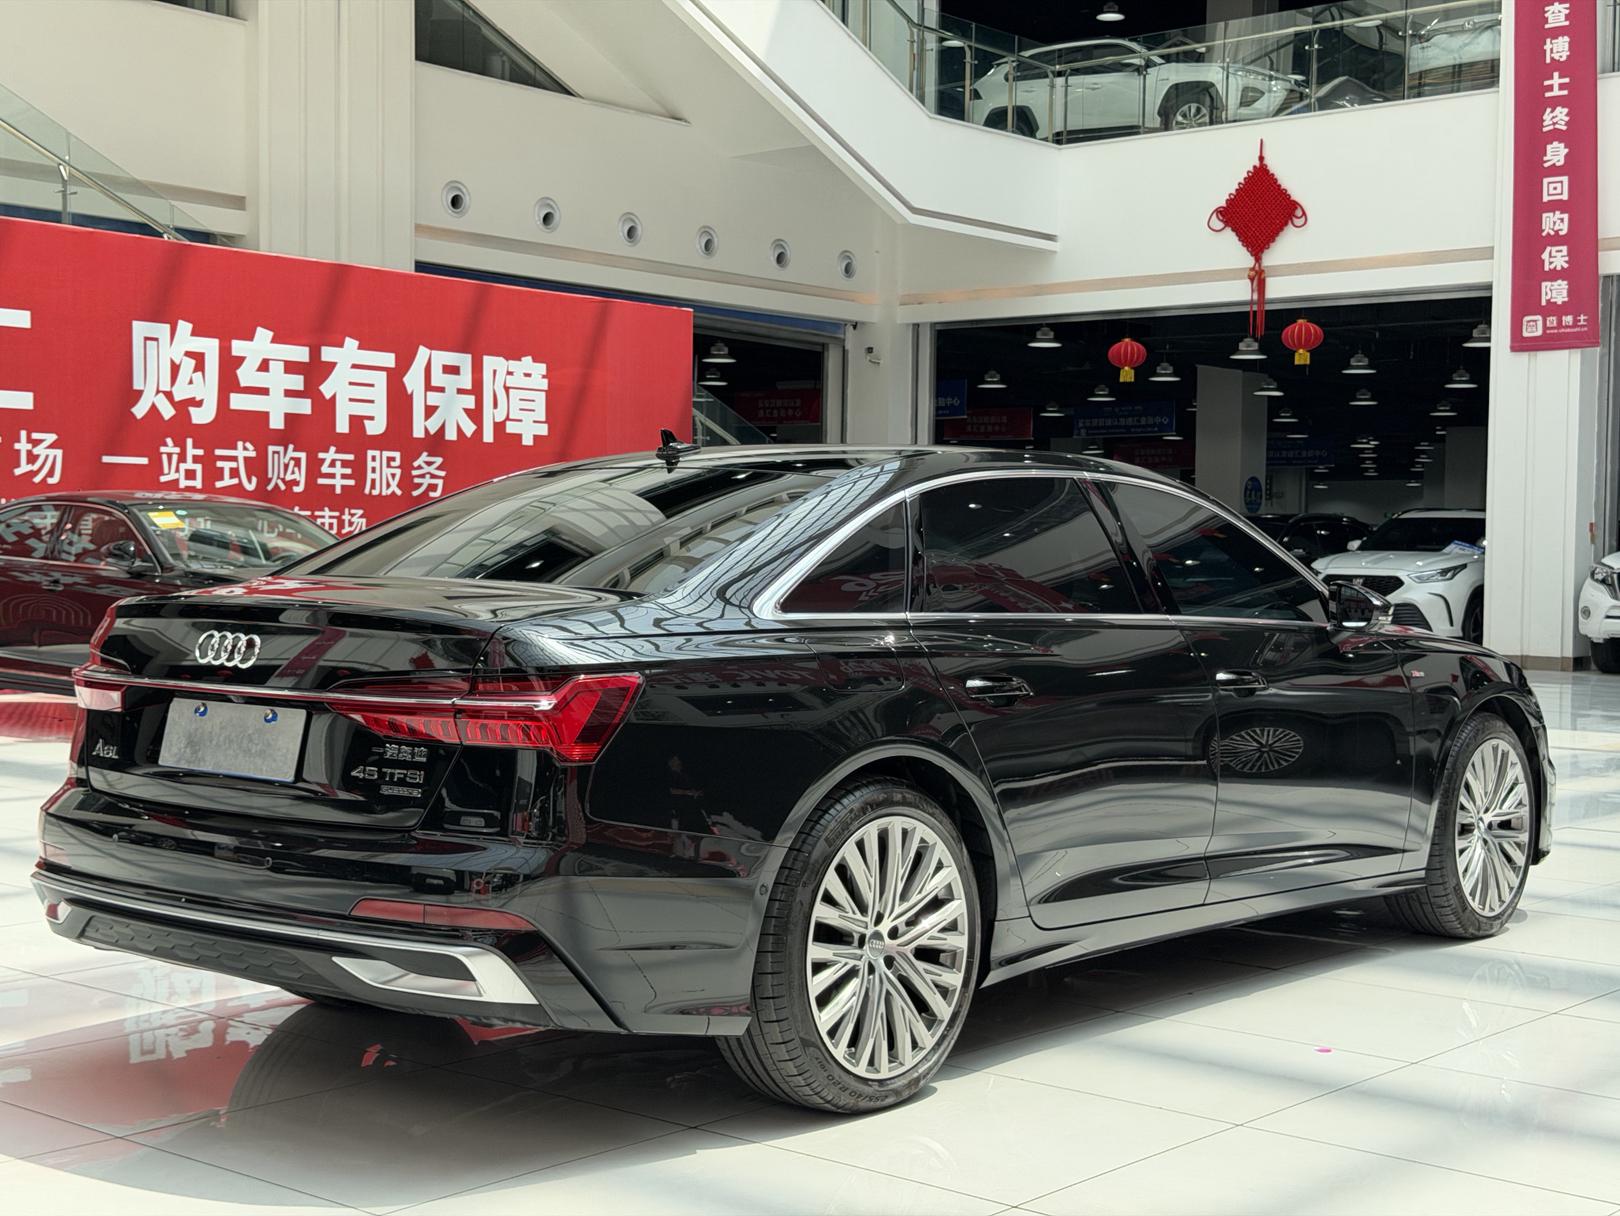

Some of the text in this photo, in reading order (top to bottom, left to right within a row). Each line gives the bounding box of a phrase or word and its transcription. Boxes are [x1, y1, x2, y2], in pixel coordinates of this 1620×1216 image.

[1540, 1, 1571, 306] 查博士终身回购保障
[130, 320, 549, 446] 购车有保障
[0, 429, 448, 498] 场 一站式购车服务
[91, 738, 119, 759] A6L
[350, 765, 425, 783] 45 TFSI
